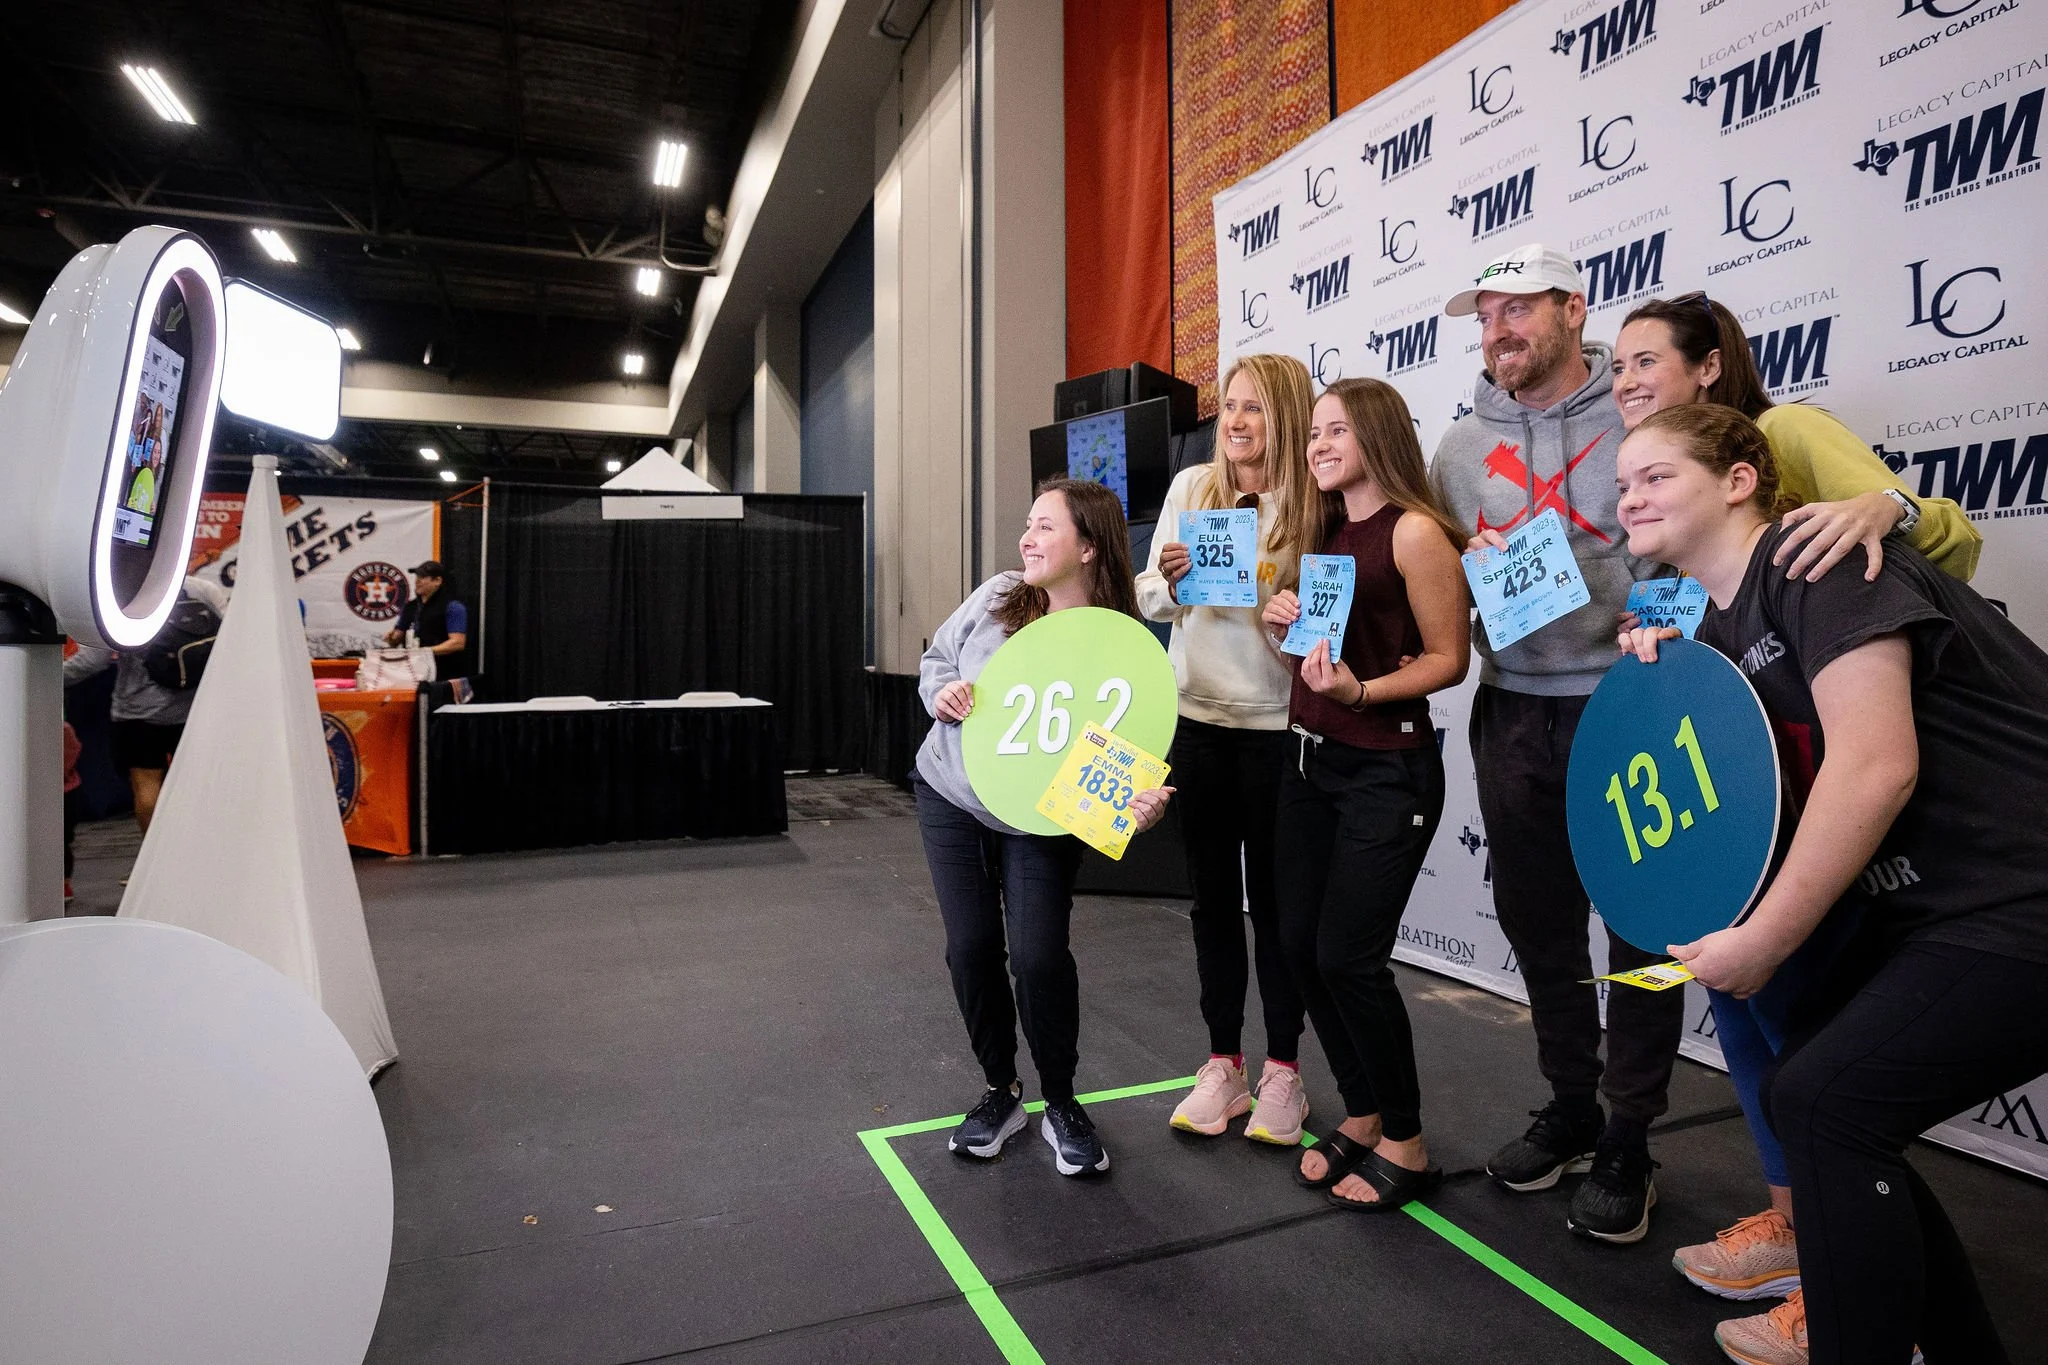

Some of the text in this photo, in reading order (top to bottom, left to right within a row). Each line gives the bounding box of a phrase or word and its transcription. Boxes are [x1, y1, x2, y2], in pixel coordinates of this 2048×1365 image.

[1579, 0, 1657, 73] TWM
[1700, 0, 1831, 70] LEGACY CAPITAL
[1879, 32, 1942, 67] LEGACY
[1945, 0, 2020, 37] CAPITAL
[1468, 65, 1515, 115] LC
[1719, 25, 1824, 129] TWM
[1877, 92, 1954, 133] LEGACY
[1381, 114, 1433, 181] TWM
[1577, 114, 1636, 171] LC
[1903, 87, 2046, 203] TWM
[1304, 165, 1337, 208] LC
[1471, 166, 1536, 238] TWM
[1568, 162, 1650, 203] LEGACY CAPITAL
[1904, 161, 2041, 213] THE WOODLANDS MARATHON
[1242, 203, 1281, 257] TWM
[1569, 205, 1673, 252] LEGACY CAPITAL
[1720, 176, 1794, 242] LC
[1379, 216, 1418, 264] LC
[1707, 236, 1811, 276] LEGACY CAPITAL
[1306, 254, 1350, 310] TWM
[1586, 230, 1666, 307] TWM
[1241, 288, 1269, 329] LC
[1770, 287, 1840, 315] CAPITAL
[1904, 258, 2006, 339] LC
[1309, 341, 1342, 387] LC
[1386, 315, 1439, 373] TWM
[1747, 316, 1832, 389] WM
[1888, 335, 2029, 373] LEGACY CAPITAL
[1886, 400, 2048, 439] LEGACY CAPITA
[1911, 433, 2048, 511] TWM
[1994, 506, 2048, 519] MARATHON
[291, 511, 377, 582] KETS
[1196, 544, 1234, 568] 325
[1199, 534, 1233, 543] EULA
[1482, 537, 1553, 584] SPENCER
[1311, 581, 1343, 592] SARAH
[1503, 557, 1547, 600] 423
[1308, 592, 1338, 618] 327
[1631, 606, 1697, 616] CAROLINE
[1077, 764, 1134, 812] 1833
[1092, 755, 1133, 784] EMMA
[1605, 714, 1720, 865] 13.1
[1396, 924, 1476, 961] RATHON
[1445, 955, 1475, 968] MGMT
